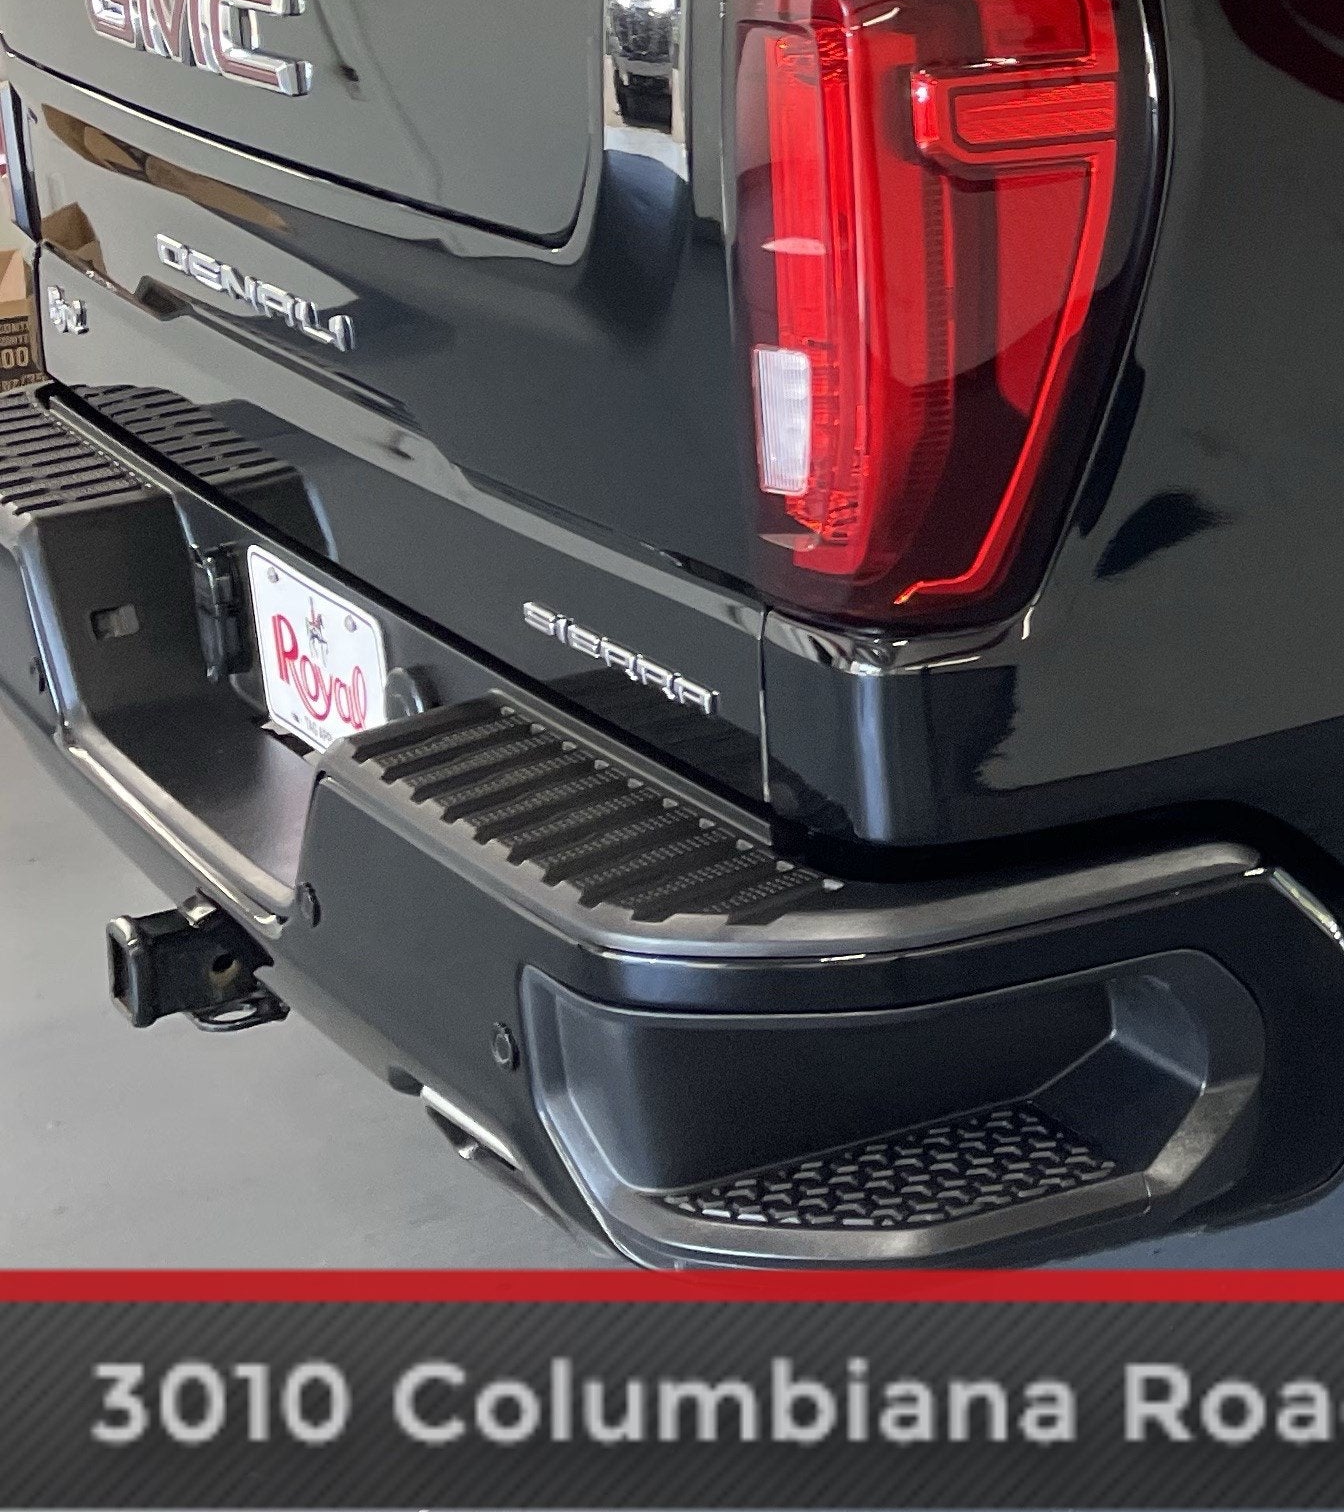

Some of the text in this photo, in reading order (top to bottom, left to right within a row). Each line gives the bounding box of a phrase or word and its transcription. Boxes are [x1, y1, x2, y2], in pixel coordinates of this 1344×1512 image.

[155, 233, 357, 353] DENALI
[271, 613, 369, 731] Royal
[523, 601, 721, 715] SIERRA
